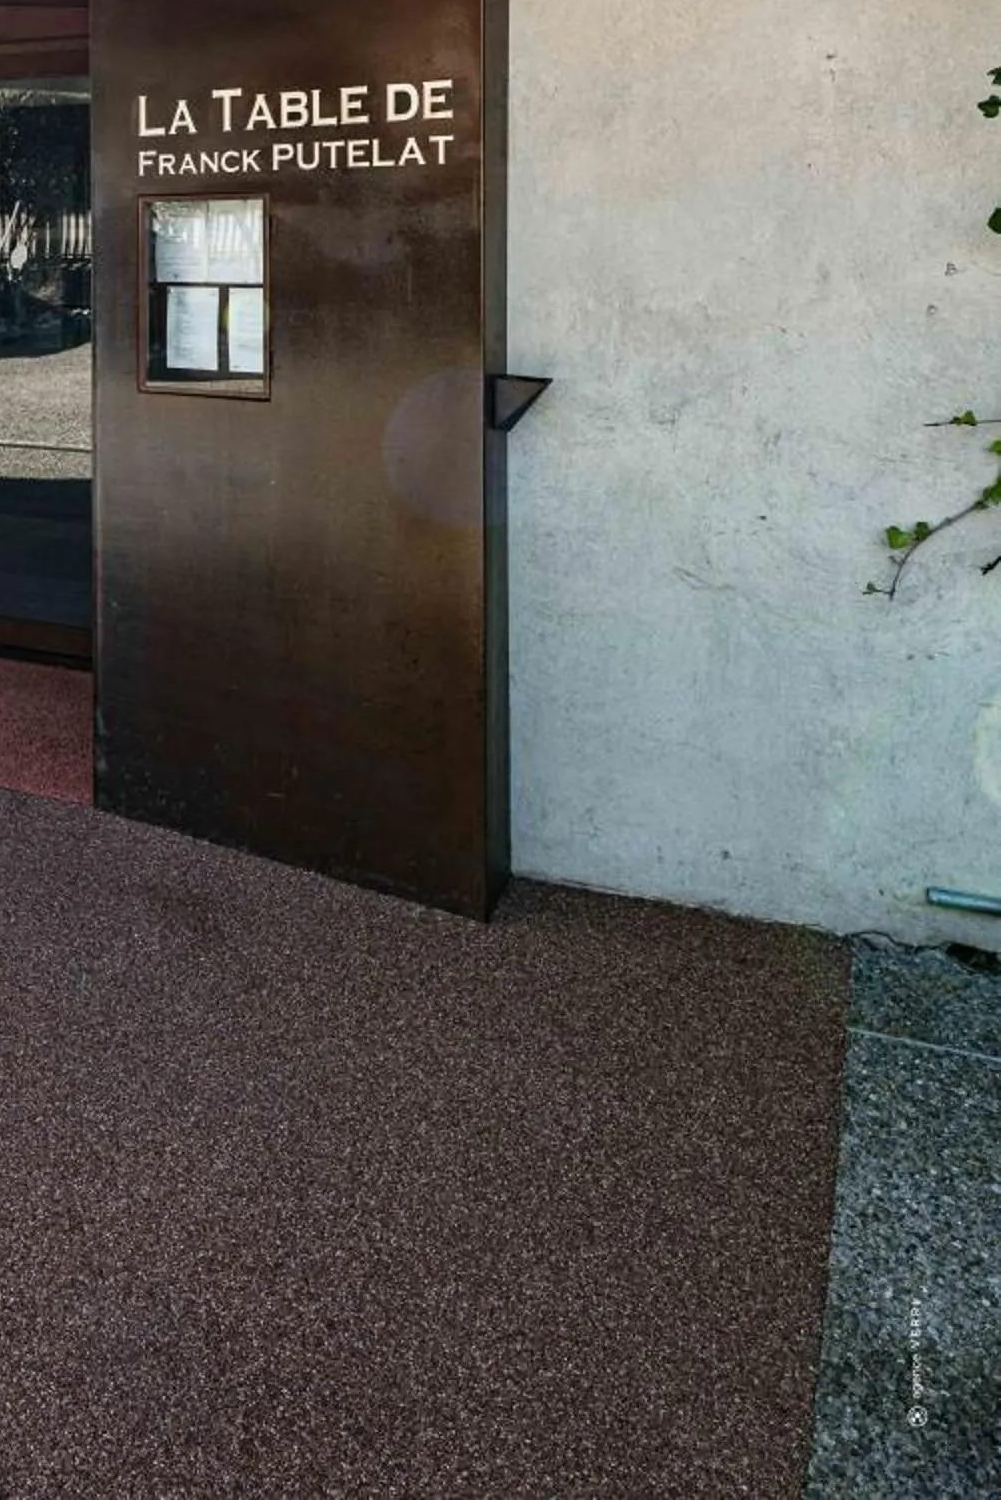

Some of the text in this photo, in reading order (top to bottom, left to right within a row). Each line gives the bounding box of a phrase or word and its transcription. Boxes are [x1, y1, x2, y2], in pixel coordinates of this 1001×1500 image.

[138, 78, 454, 137] LA TABLE DE
[138, 134, 455, 177] FRANCK PUTELAT
